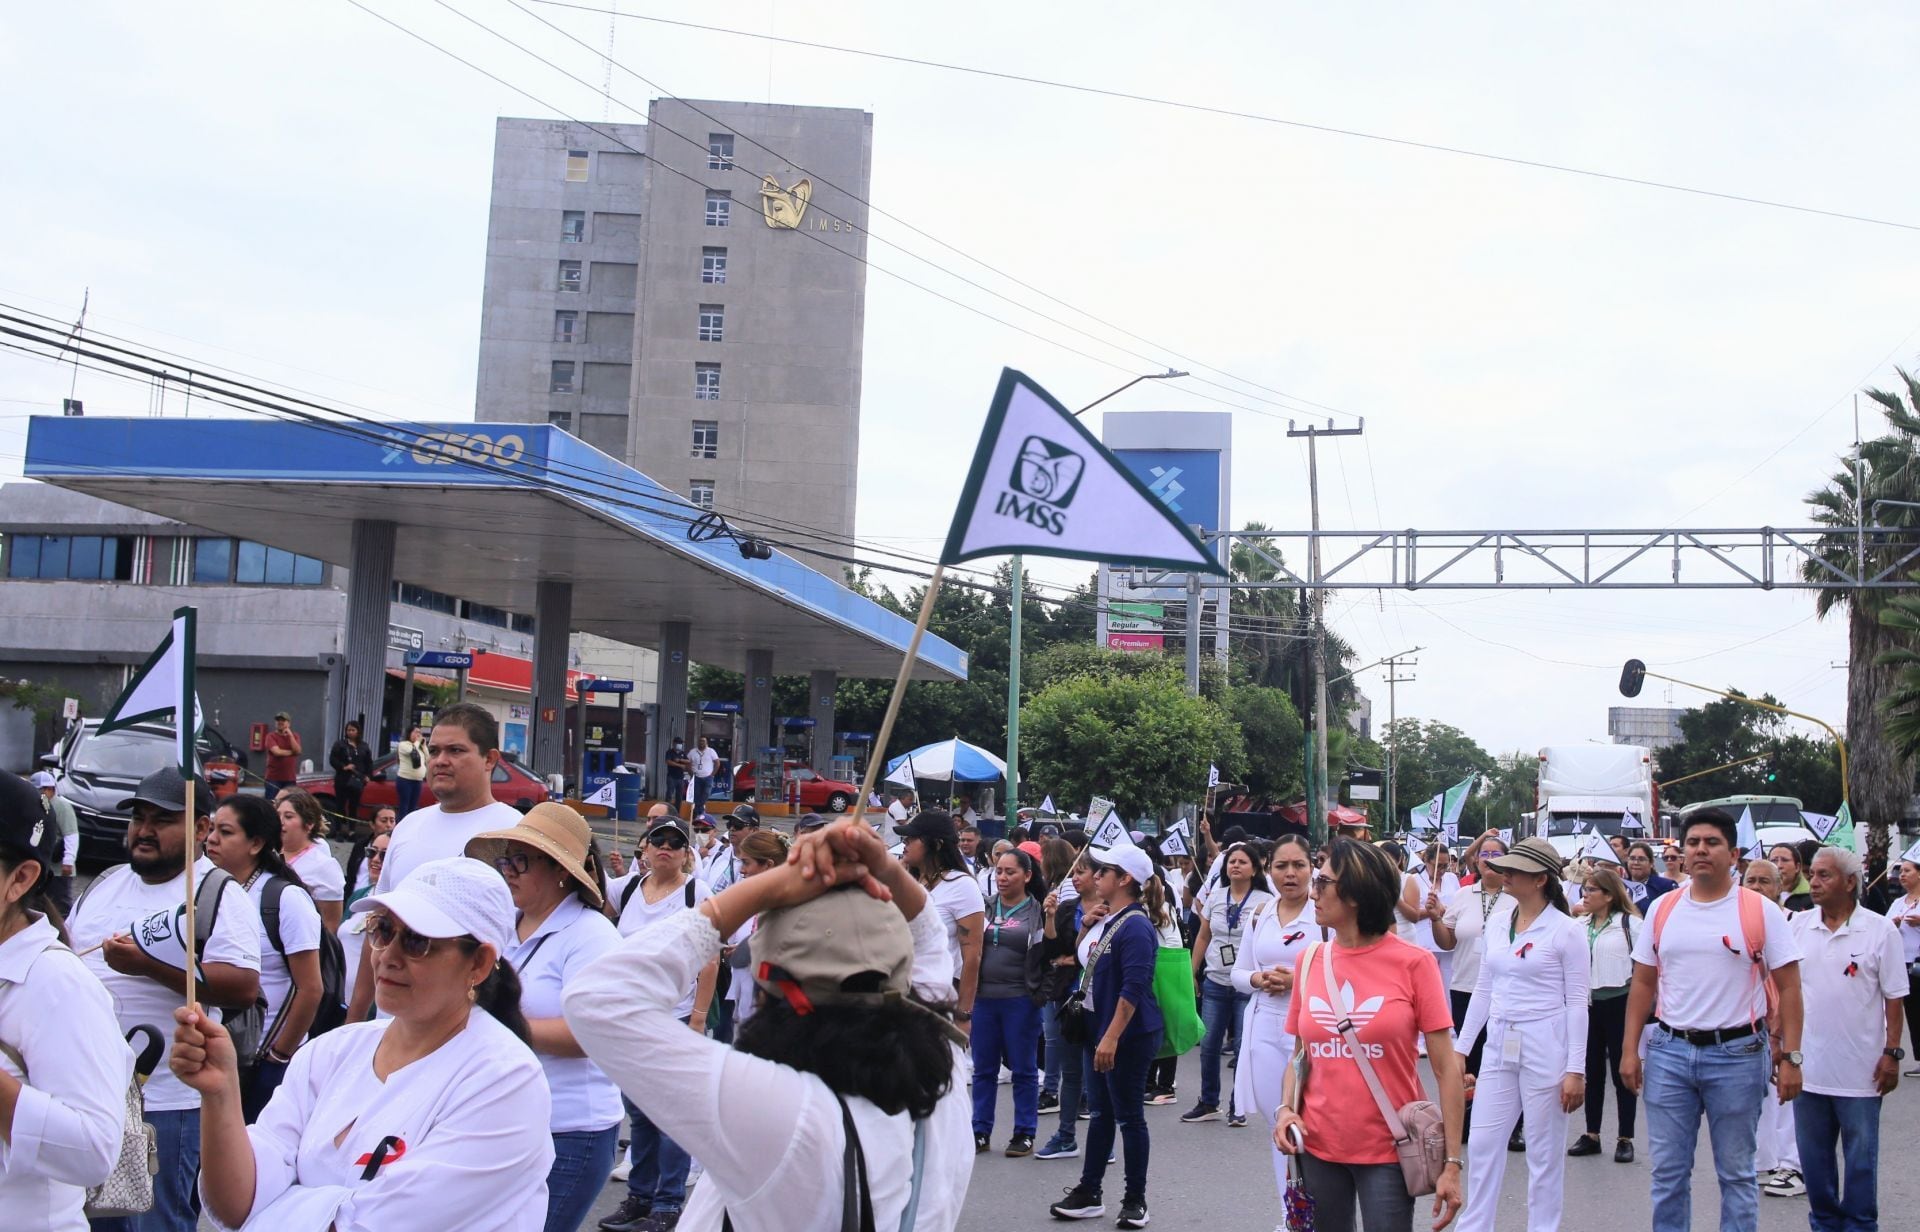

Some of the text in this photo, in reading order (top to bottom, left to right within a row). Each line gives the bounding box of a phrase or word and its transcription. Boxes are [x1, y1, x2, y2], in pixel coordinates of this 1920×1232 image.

[809, 218, 853, 233] IMSS
[994, 491, 1067, 536] IMSS
[1111, 621, 1140, 630] Regular
[1120, 640, 1150, 648] Premium
[444, 655, 470, 665] G500
